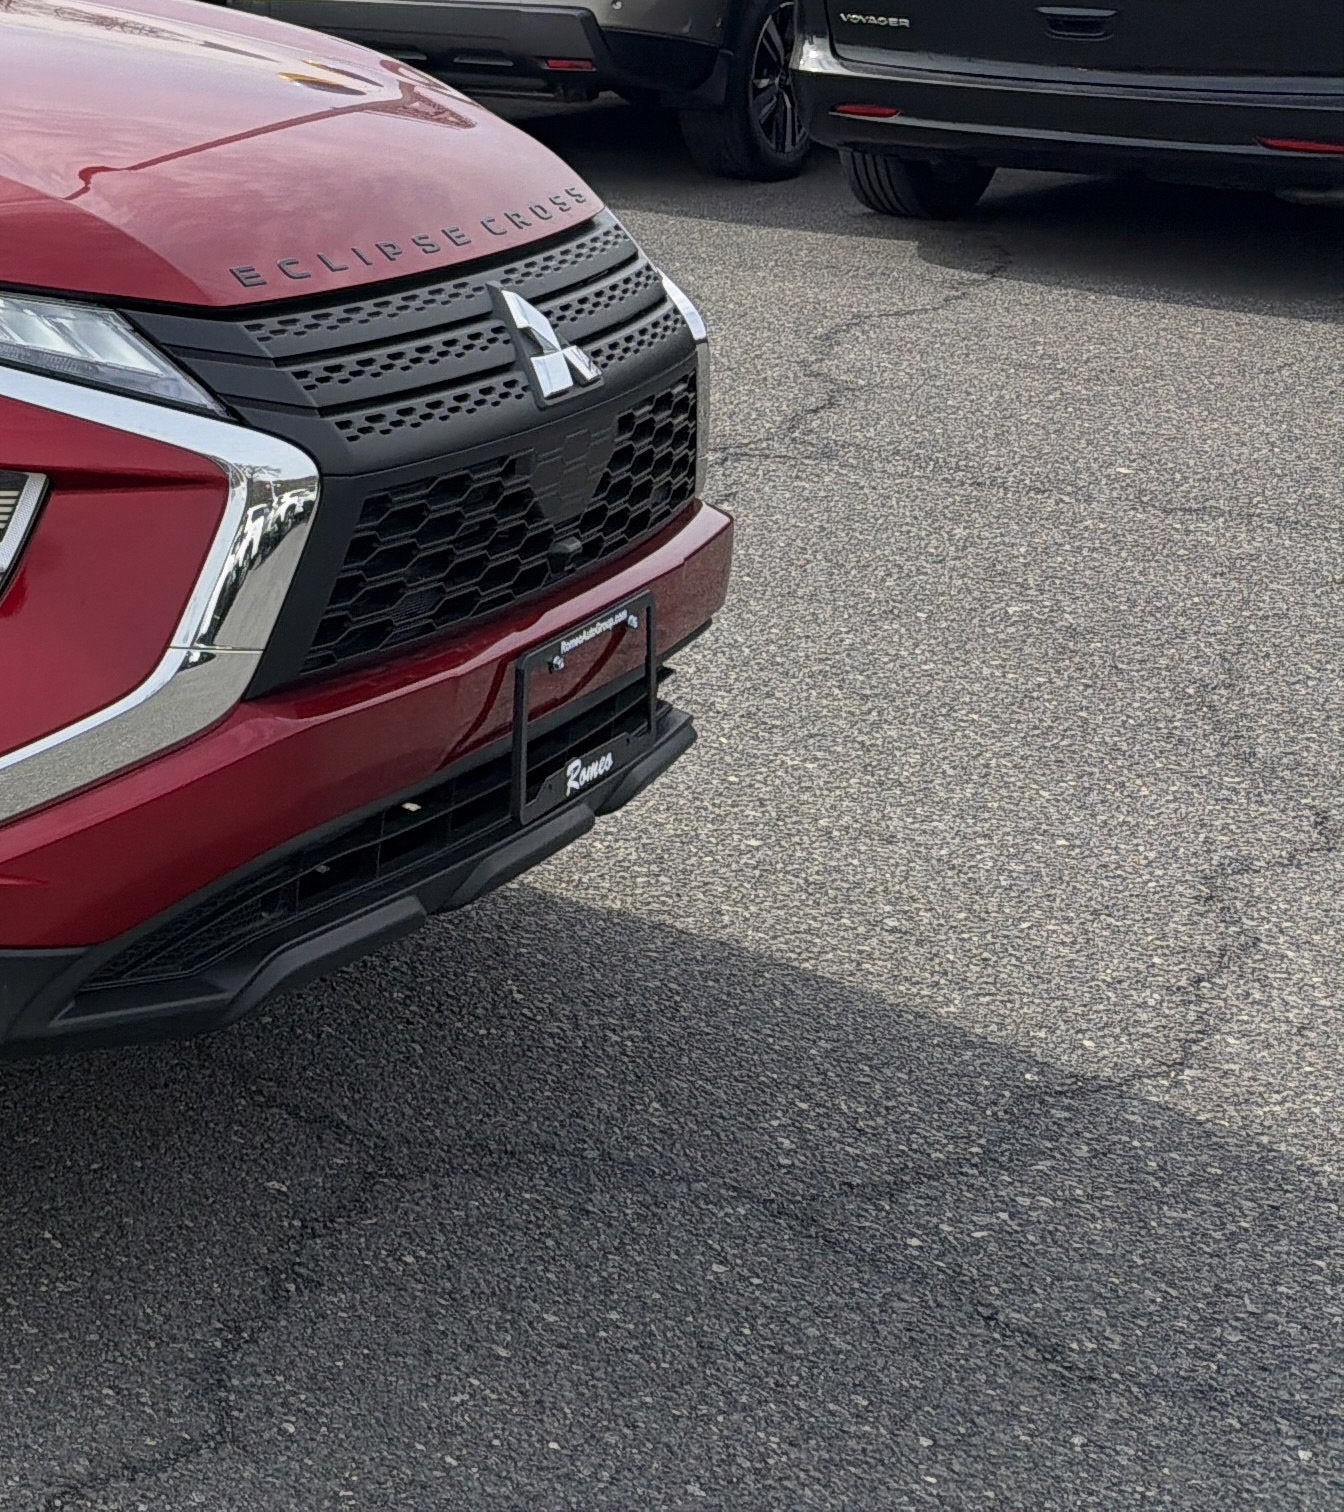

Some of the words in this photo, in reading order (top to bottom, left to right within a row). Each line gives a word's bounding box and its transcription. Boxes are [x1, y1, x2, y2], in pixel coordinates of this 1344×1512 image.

[839, 13, 910, 28] VOYAGER
[228, 226, 472, 288] ECLIPSE
[479, 186, 588, 236] CROSS
[565, 751, 614, 798] Romeo
